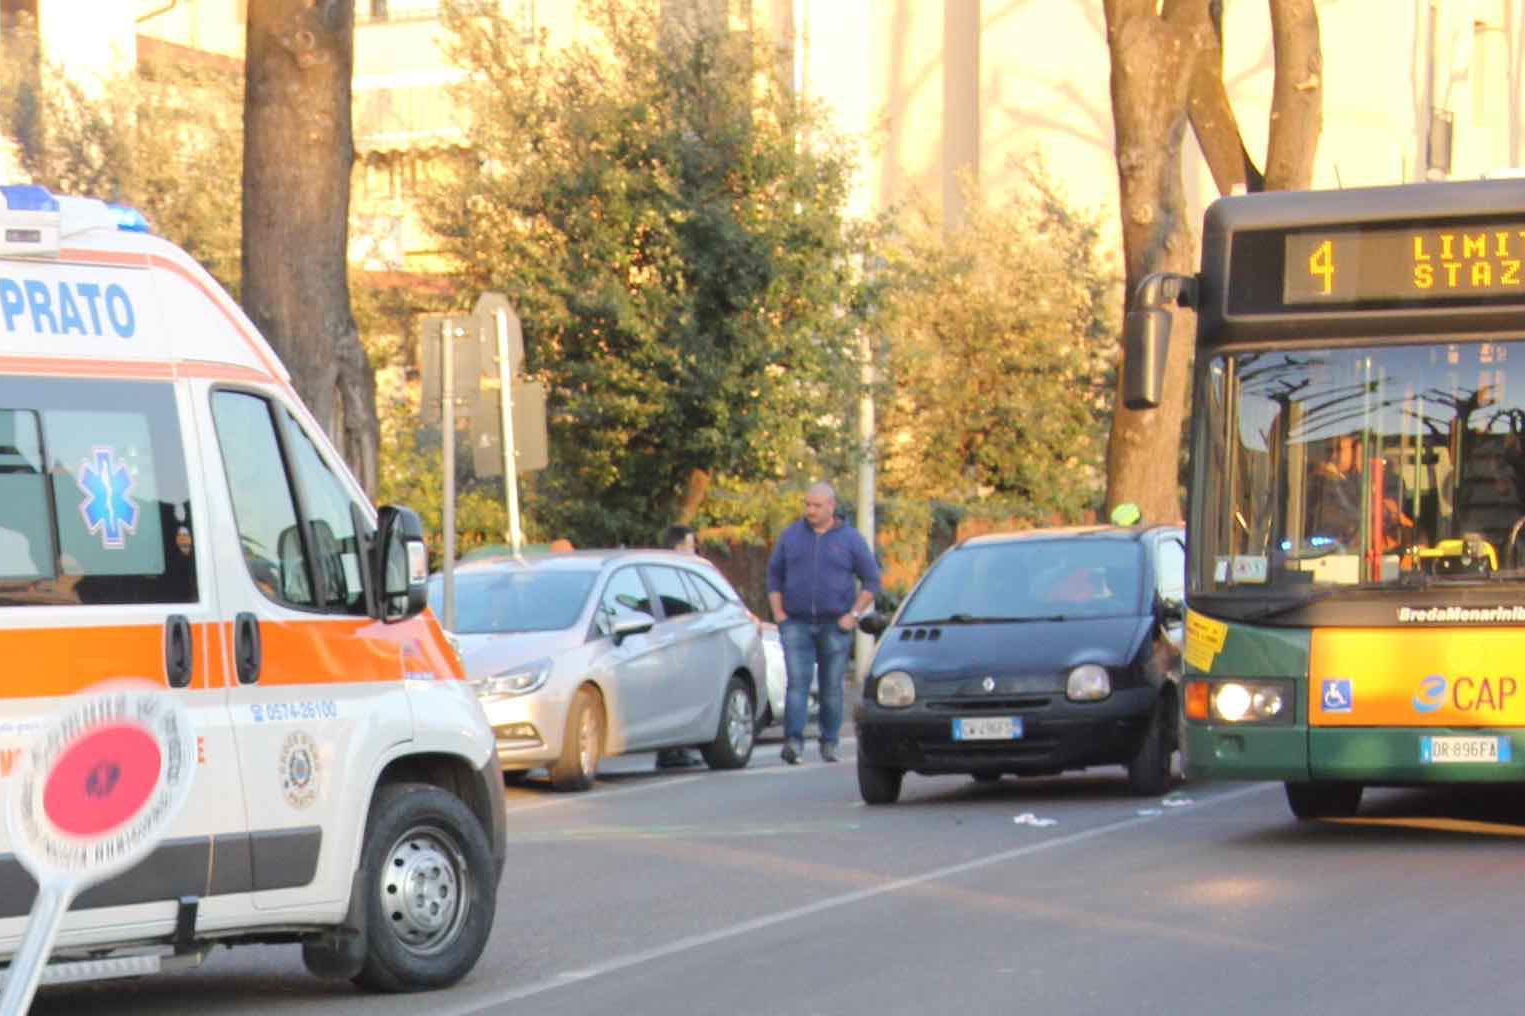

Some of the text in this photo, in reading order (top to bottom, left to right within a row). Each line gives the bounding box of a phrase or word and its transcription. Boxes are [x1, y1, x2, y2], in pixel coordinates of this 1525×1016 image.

[1309, 240, 1334, 296] 4
[1413, 260, 1521, 288] STAZ
[1452, 675, 1517, 712] CAP
